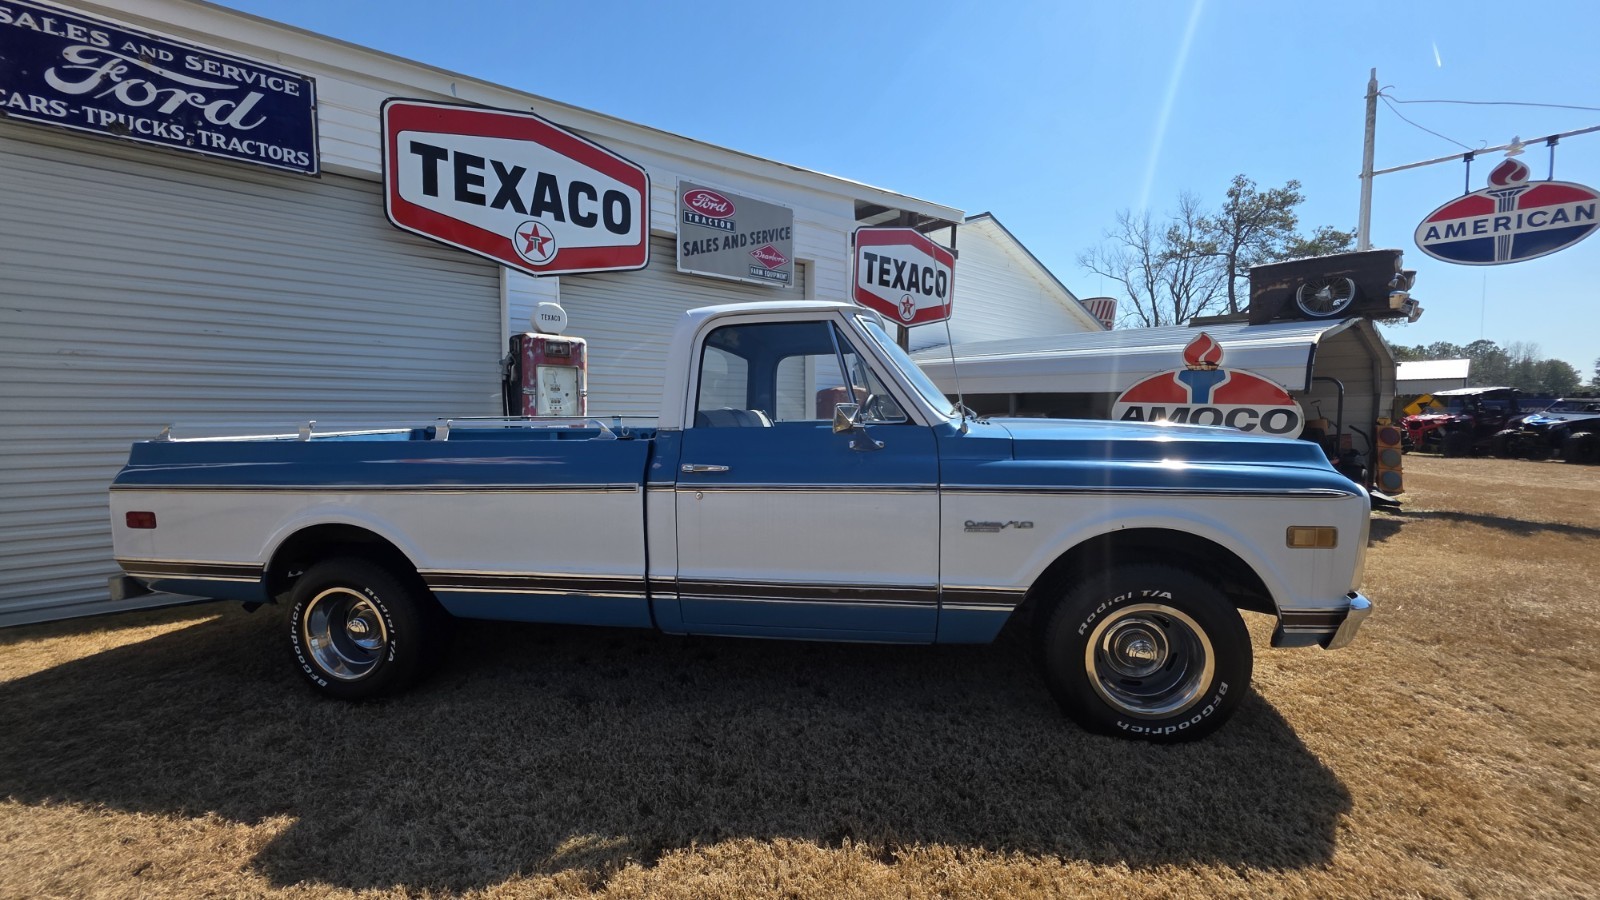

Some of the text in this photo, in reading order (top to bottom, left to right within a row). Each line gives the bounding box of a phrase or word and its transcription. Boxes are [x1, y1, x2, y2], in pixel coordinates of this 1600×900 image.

[0, 6, 300, 97] SALES AND SERVICE
[44, 45, 267, 130] Ford
[409, 140, 631, 235] TEXACO
[692, 193, 728, 213] Ford
[683, 226, 791, 257] SALES AND SERVICE
[688, 213, 731, 229] TRACTOR
[1423, 203, 1596, 241] AMERICAN
[864, 251, 947, 298] TEXACO
[541, 313, 561, 322] TEXACO
[1120, 406, 1298, 434] AMOCO
[364, 587, 396, 661] Radial T/A
[1078, 589, 1172, 636] Radial T/A
[290, 602, 328, 687] BFGoodrich
[1117, 681, 1229, 735] BFGoodrich
